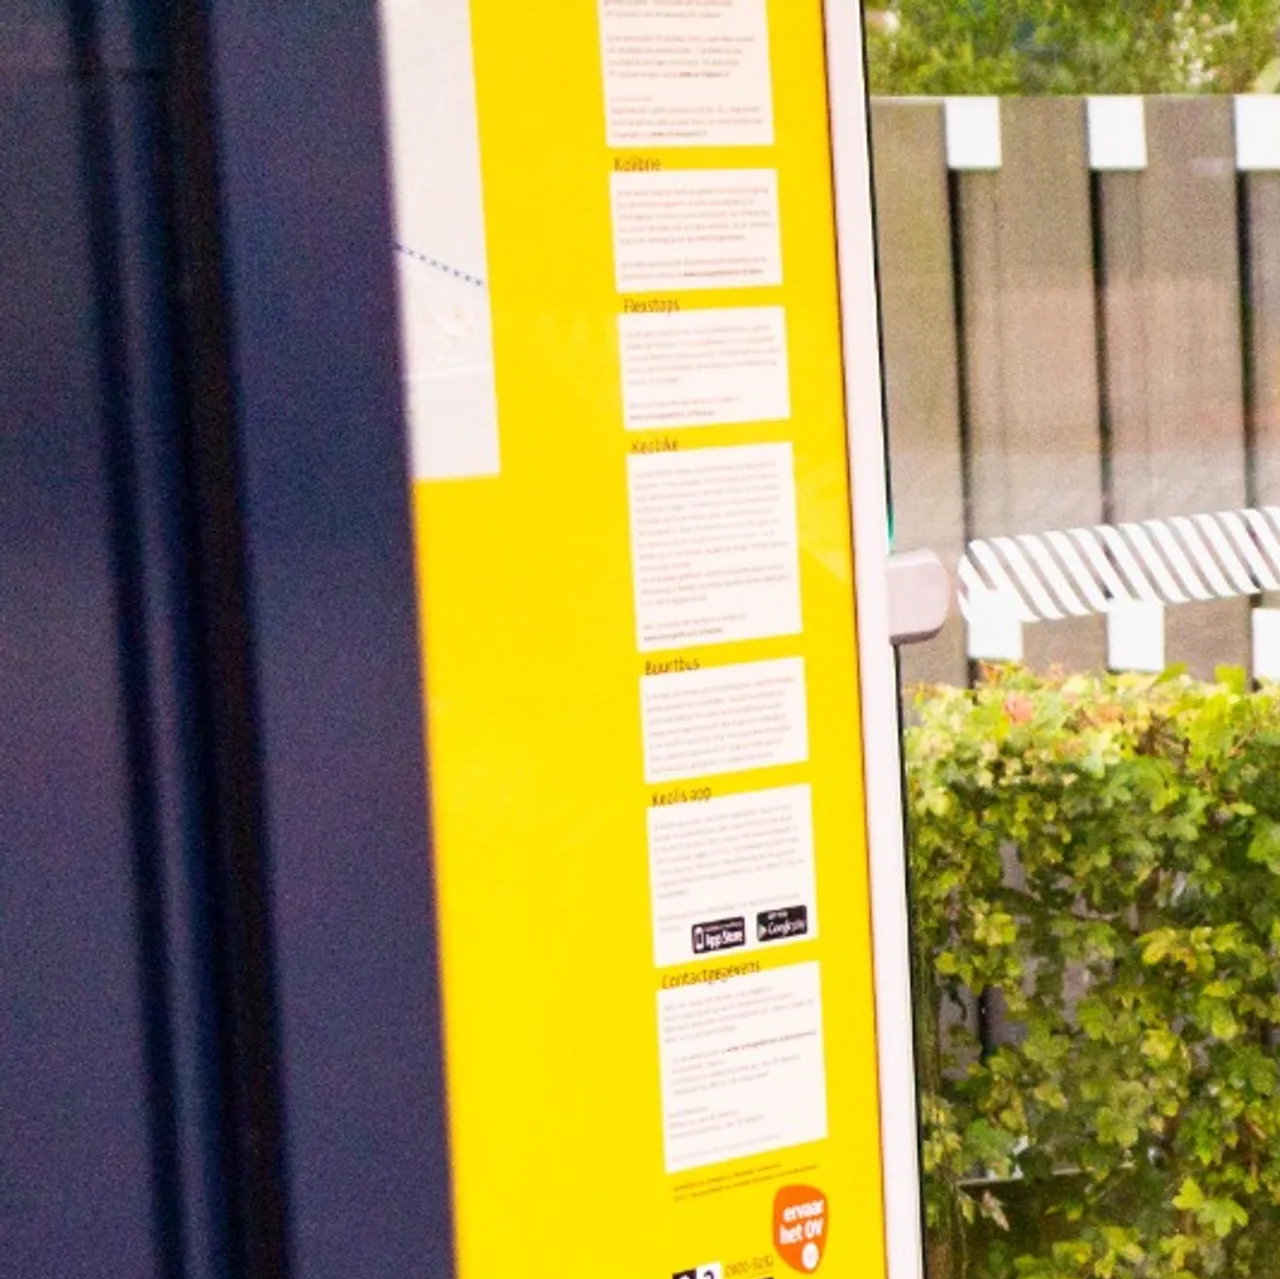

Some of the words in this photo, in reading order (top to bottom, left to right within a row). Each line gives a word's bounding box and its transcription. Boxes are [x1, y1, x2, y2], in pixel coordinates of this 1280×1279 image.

[645, 657, 700, 676] Buurtbus
[651, 790, 688, 808] Keolis
[689, 786, 712, 804] app
[705, 931, 722, 950] App
[722, 929, 743, 945] Store
[660, 959, 762, 990] Contactgegevens
[782, 1199, 824, 1222] ervaar
[779, 1223, 803, 1245] het
[803, 1217, 824, 1239] OV
